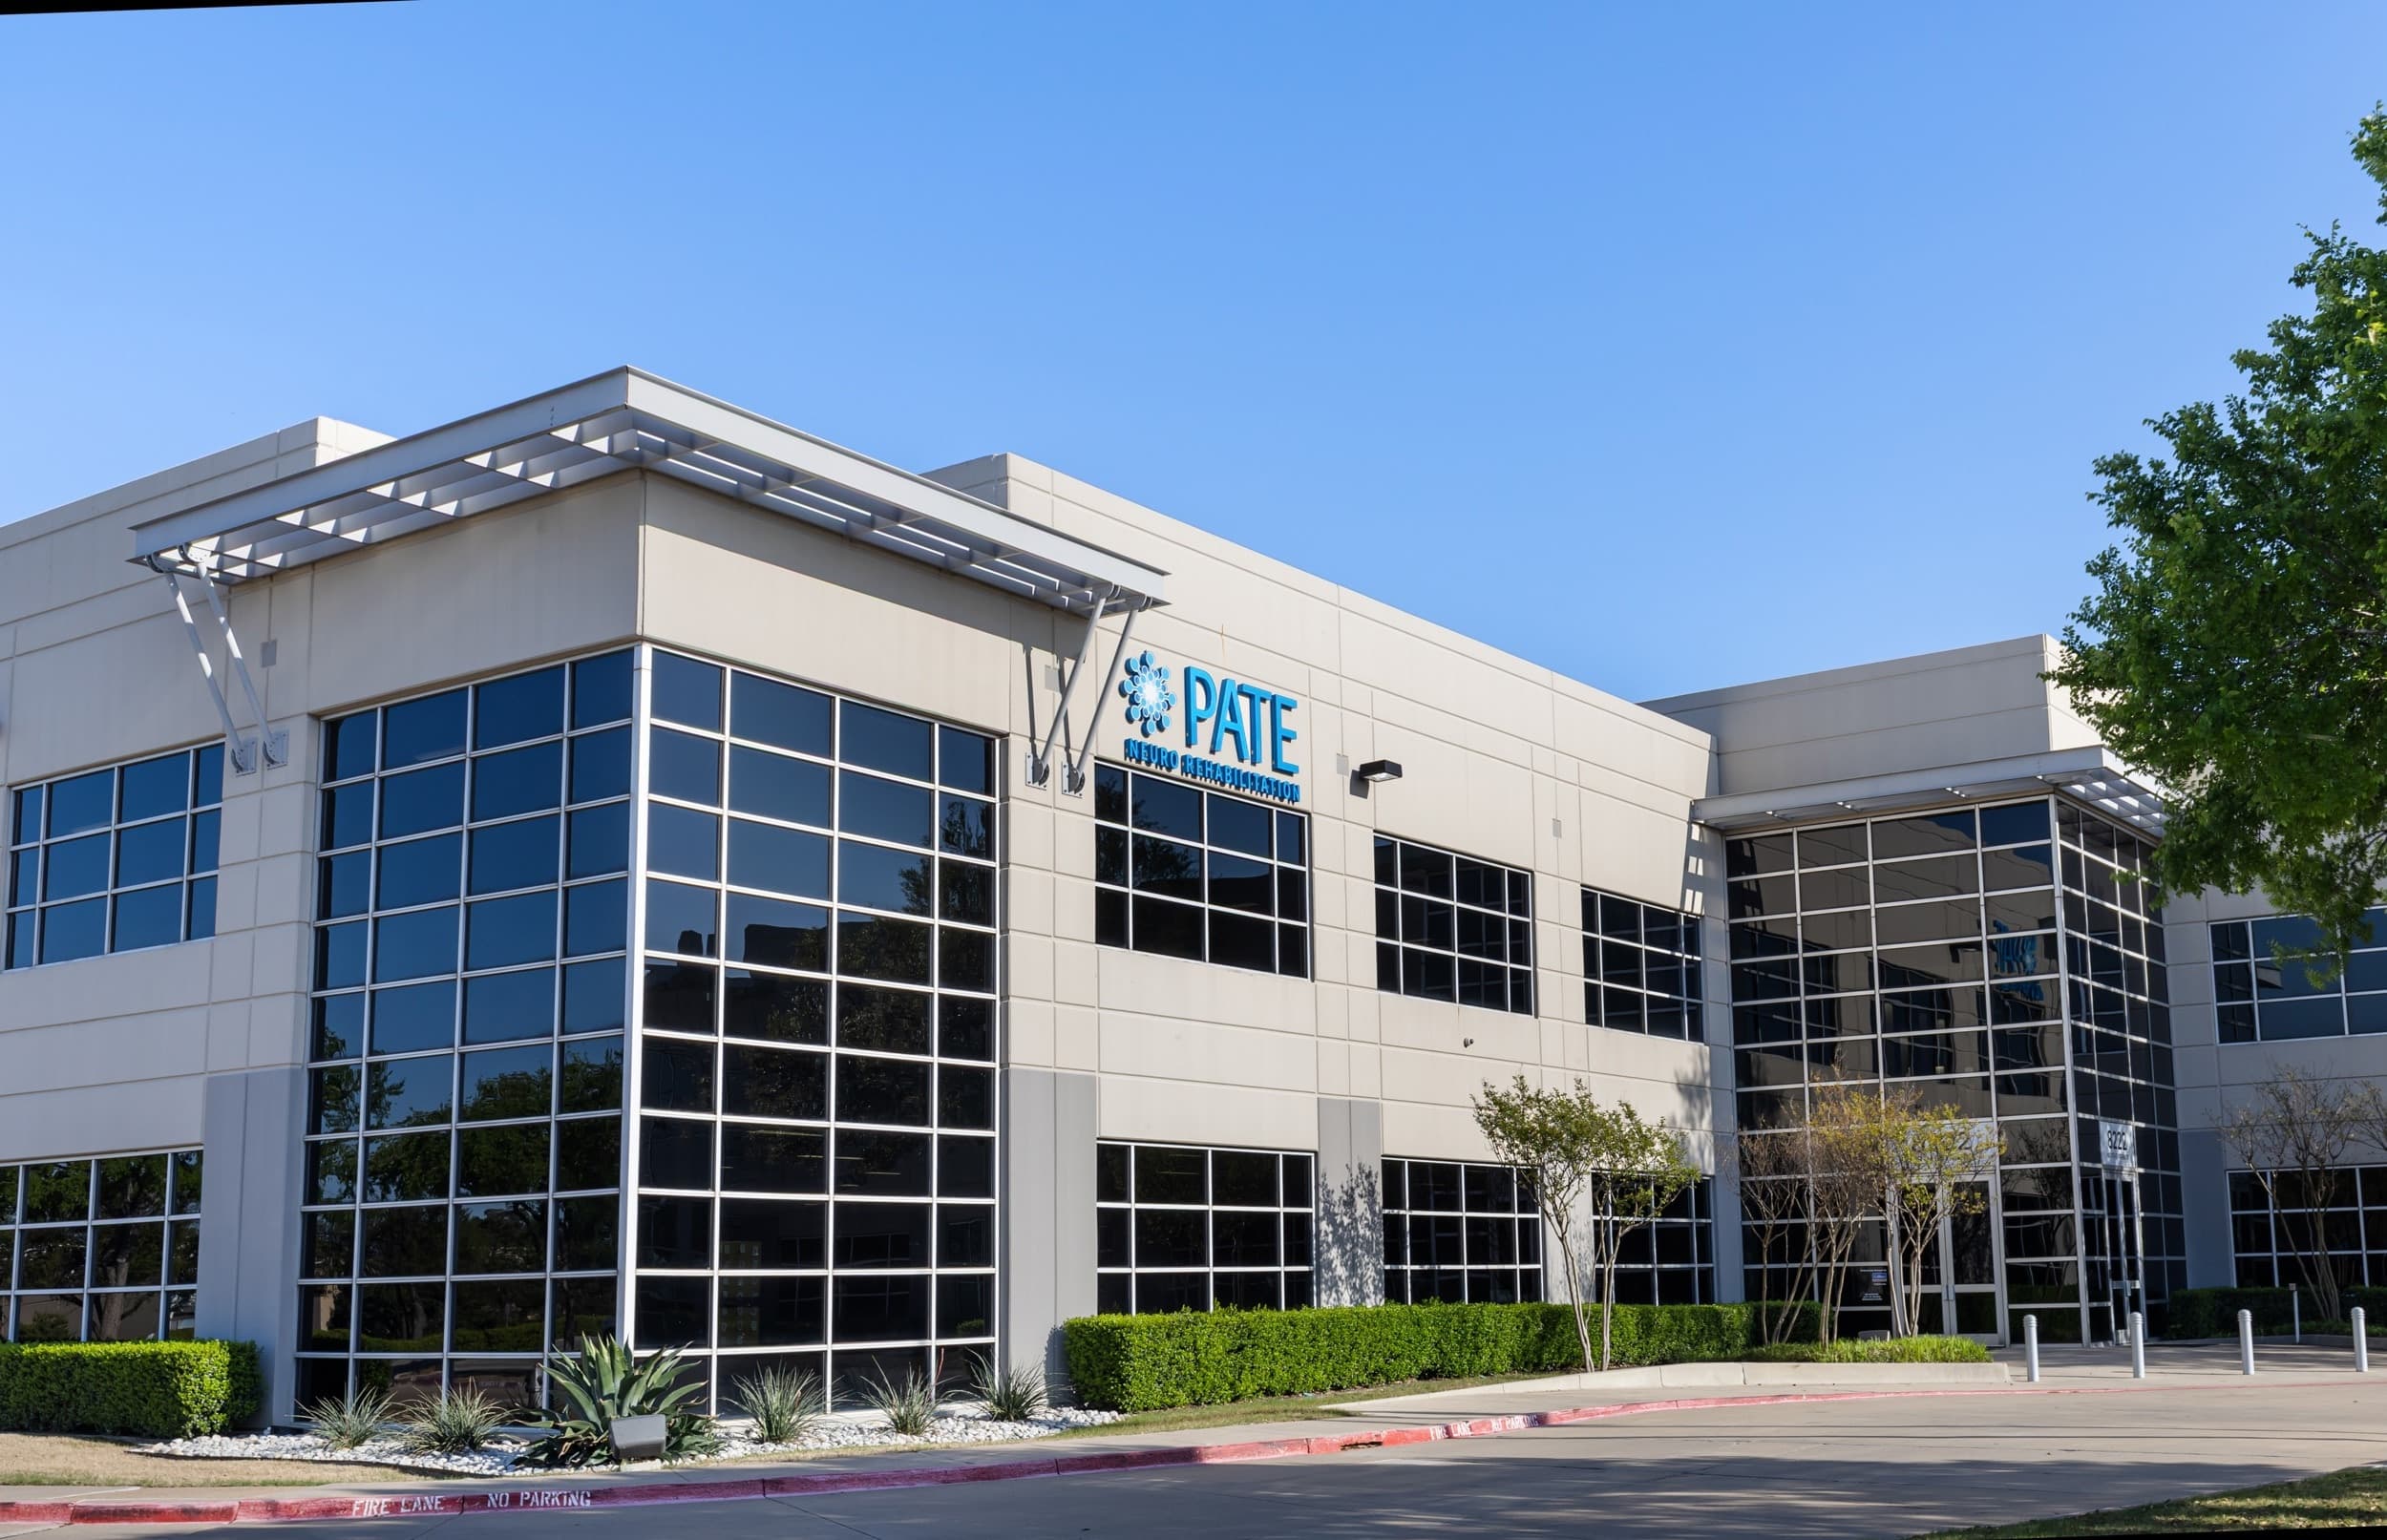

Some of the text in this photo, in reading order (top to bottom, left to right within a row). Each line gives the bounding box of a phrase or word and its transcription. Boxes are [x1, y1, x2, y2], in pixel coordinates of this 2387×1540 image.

[1184, 666, 1299, 774] PATE
[1124, 738, 1300, 804] NEURO REHABILITATION
[2107, 1130, 2127, 1150] 8222
[1429, 1414, 1538, 1441] FIRE LANE NO PARKING
[352, 1490, 591, 1516] FIRE LANE NO PARKING
